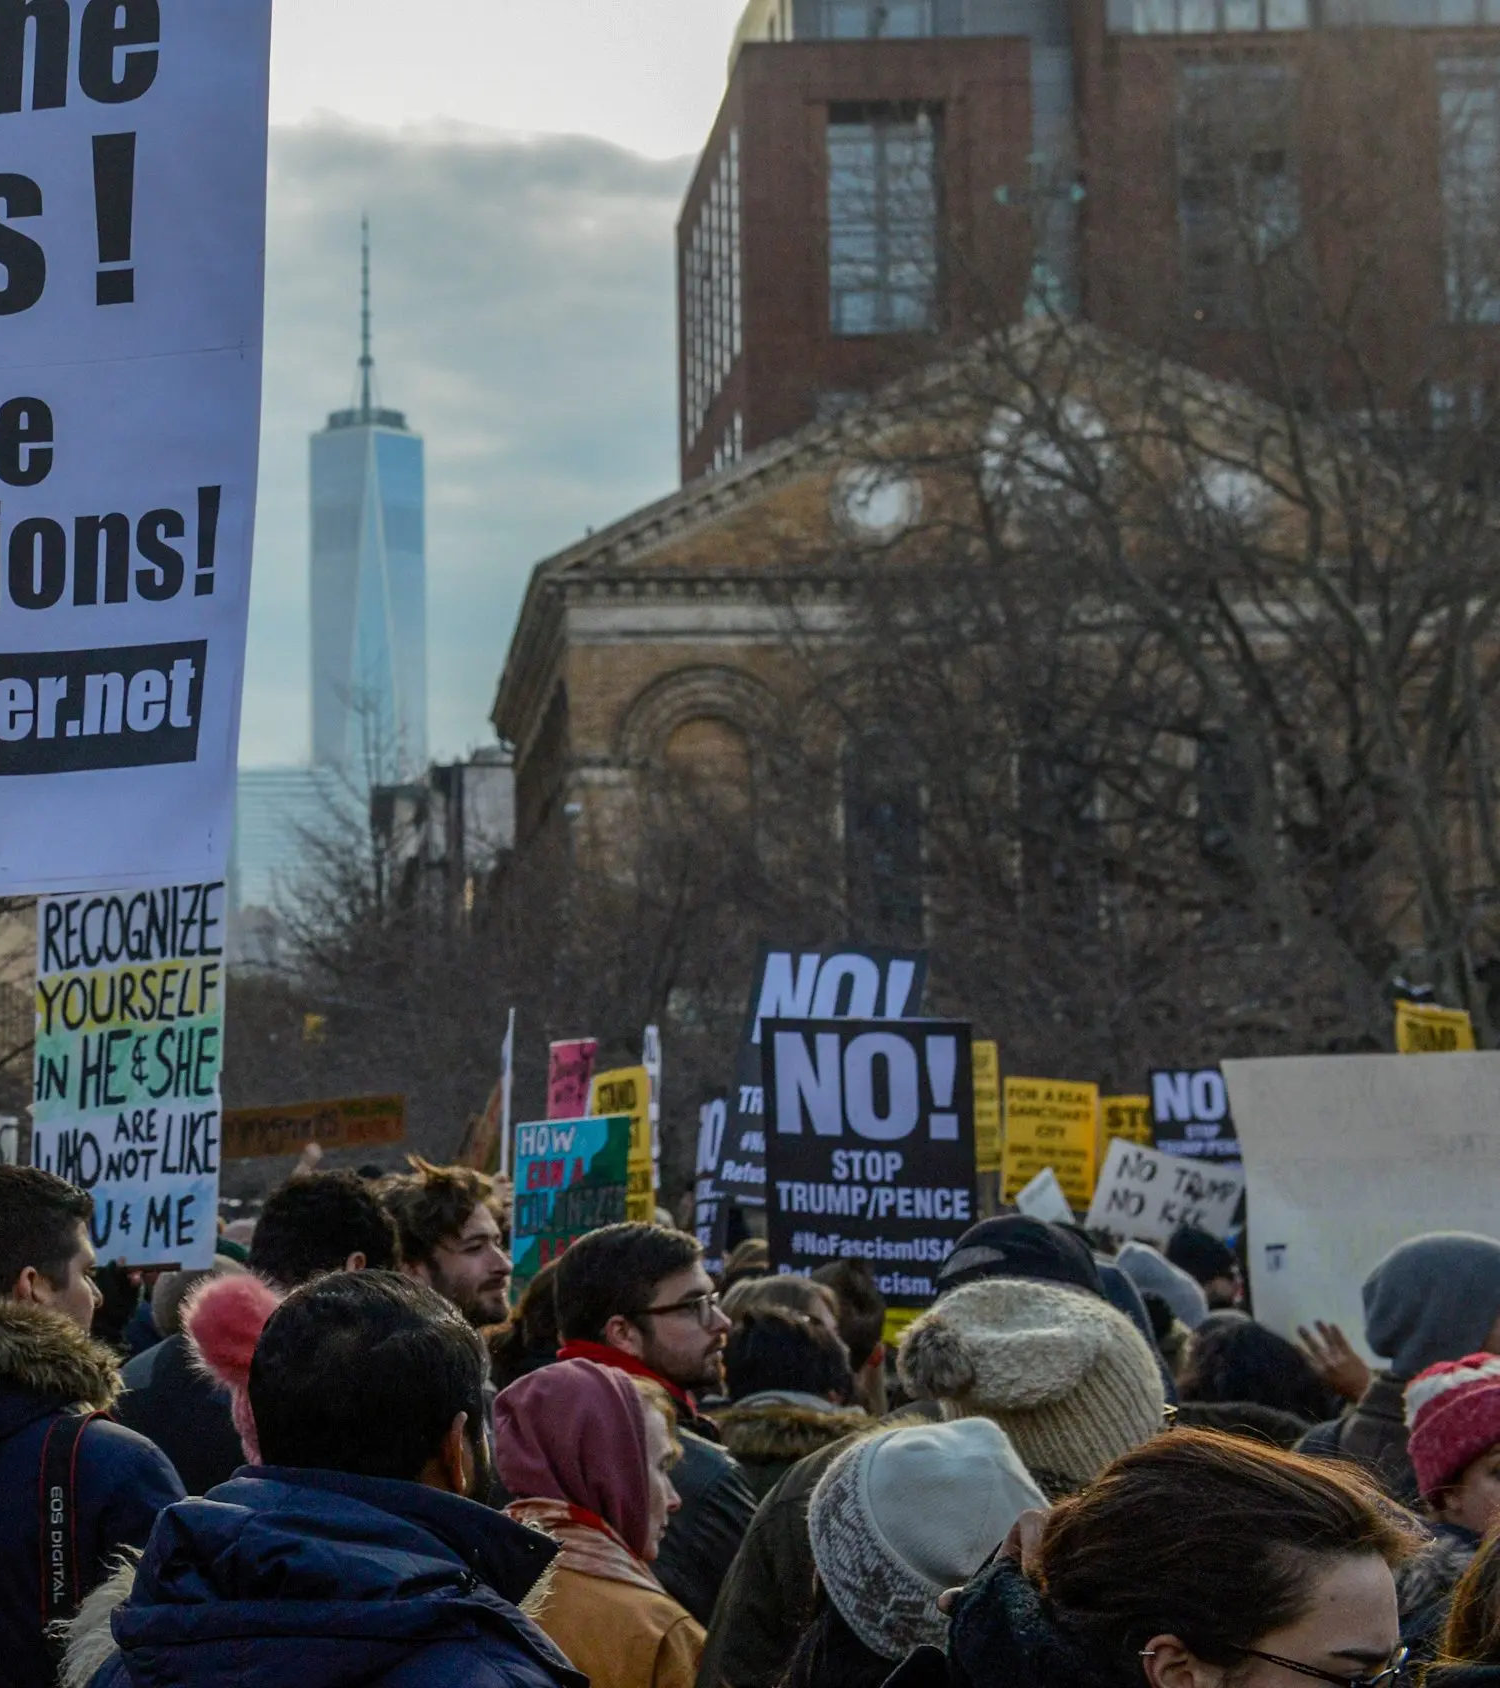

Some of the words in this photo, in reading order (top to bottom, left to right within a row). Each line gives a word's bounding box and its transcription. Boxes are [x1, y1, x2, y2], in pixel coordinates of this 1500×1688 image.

[44, 881, 225, 973] RECOGNIZE
[38, 963, 219, 1035] YOURSELF
[35, 1053, 69, 1101] IN
[78, 1029, 132, 1109] HE
[148, 1026, 217, 1098] SHE
[774, 1031, 958, 1140] NO!
[113, 1108, 158, 1146] ARE
[160, 1110, 217, 1176] LIKE
[520, 1125, 576, 1157] HOW
[34, 1127, 101, 1189] WHO
[106, 1148, 158, 1181] NOT
[832, 1149, 903, 1183] STOP
[1116, 1152, 1158, 1182] NO
[142, 1195, 195, 1248] ME
[776, 1181, 971, 1220] TRUMP/PENCE
[1106, 1188, 1146, 1217] NO
[50, 1485, 64, 1528] EOS
[51, 1531, 65, 1604] DIGITAL
